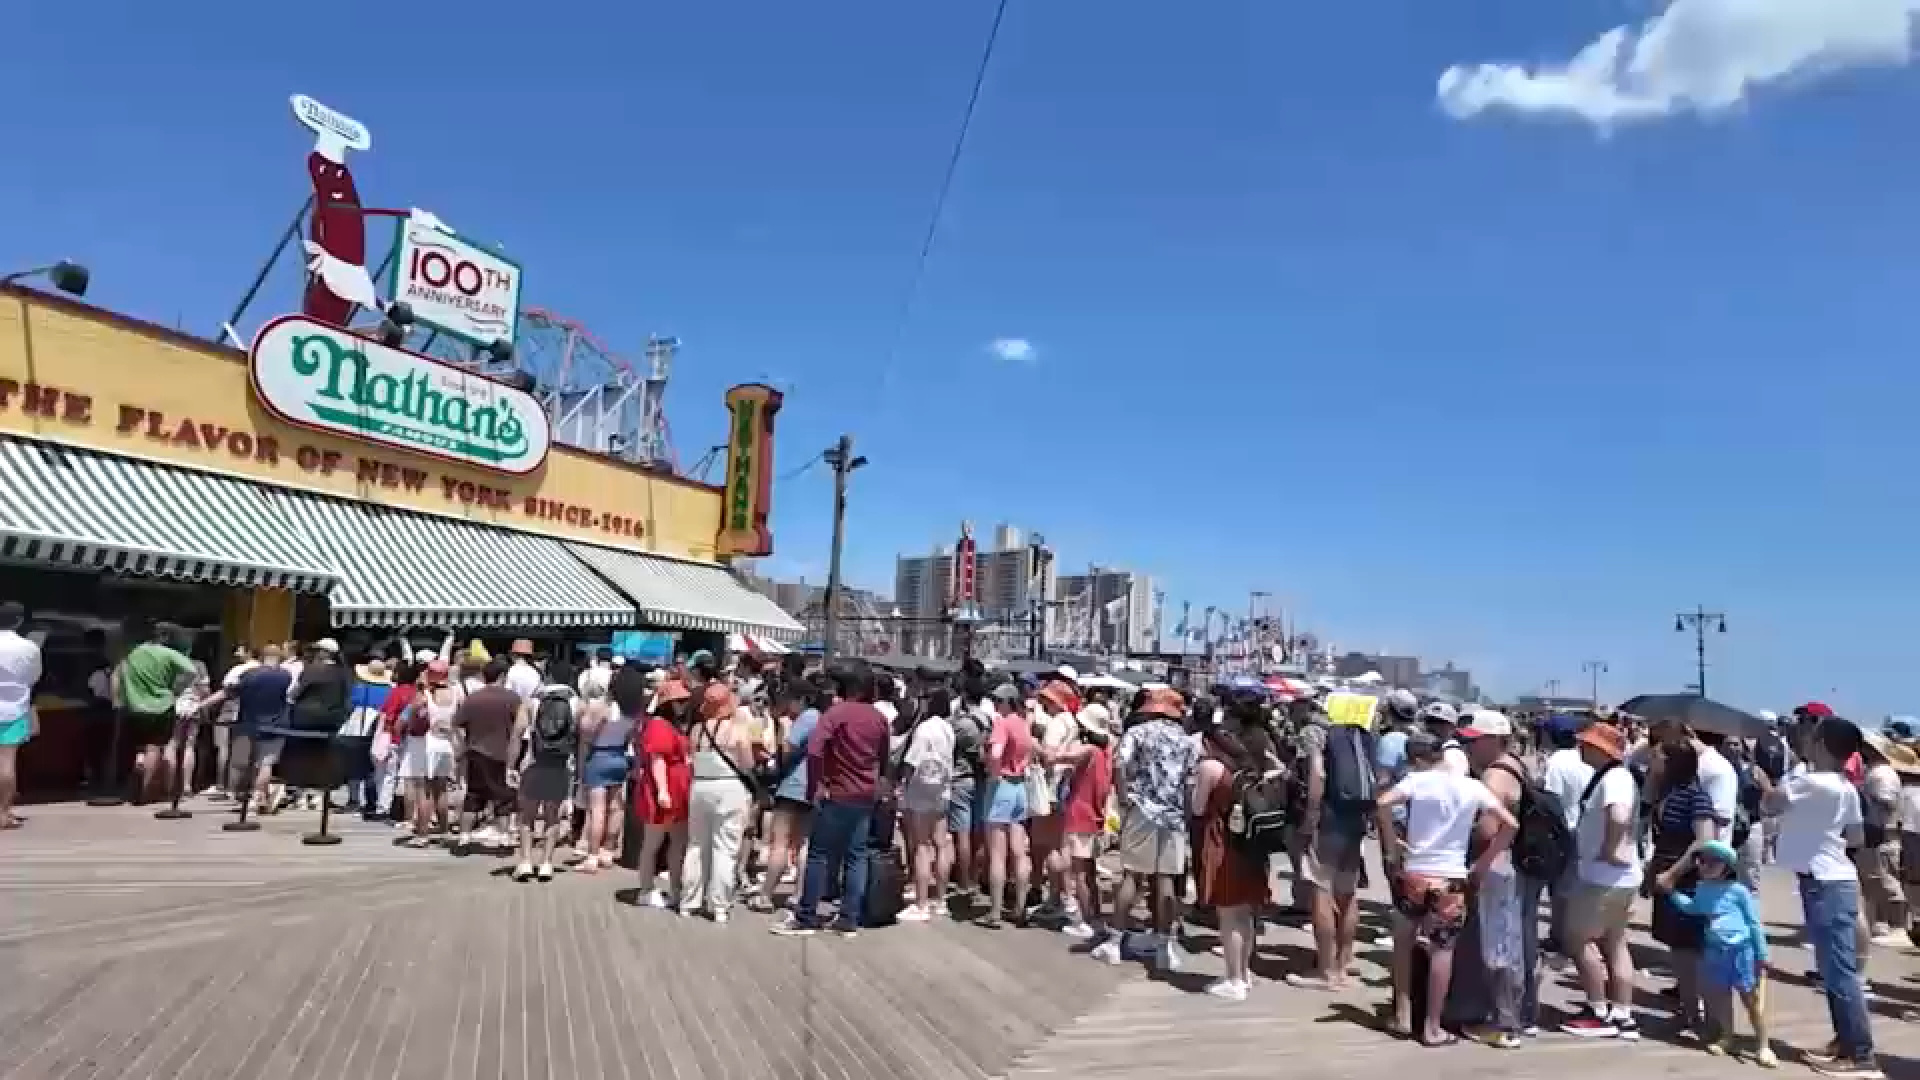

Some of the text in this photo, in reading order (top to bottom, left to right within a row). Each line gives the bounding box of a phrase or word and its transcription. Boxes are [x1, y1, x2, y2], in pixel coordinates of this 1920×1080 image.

[406, 283, 506, 319] ANNIVERSARY
[0, 378, 92, 423] THE
[116, 403, 279, 467] FLAVOR
[297, 444, 342, 477] OF
[357, 457, 428, 495] NEW
[440, 473, 512, 511] YORK
[290, 334, 522, 445] Nathan's
